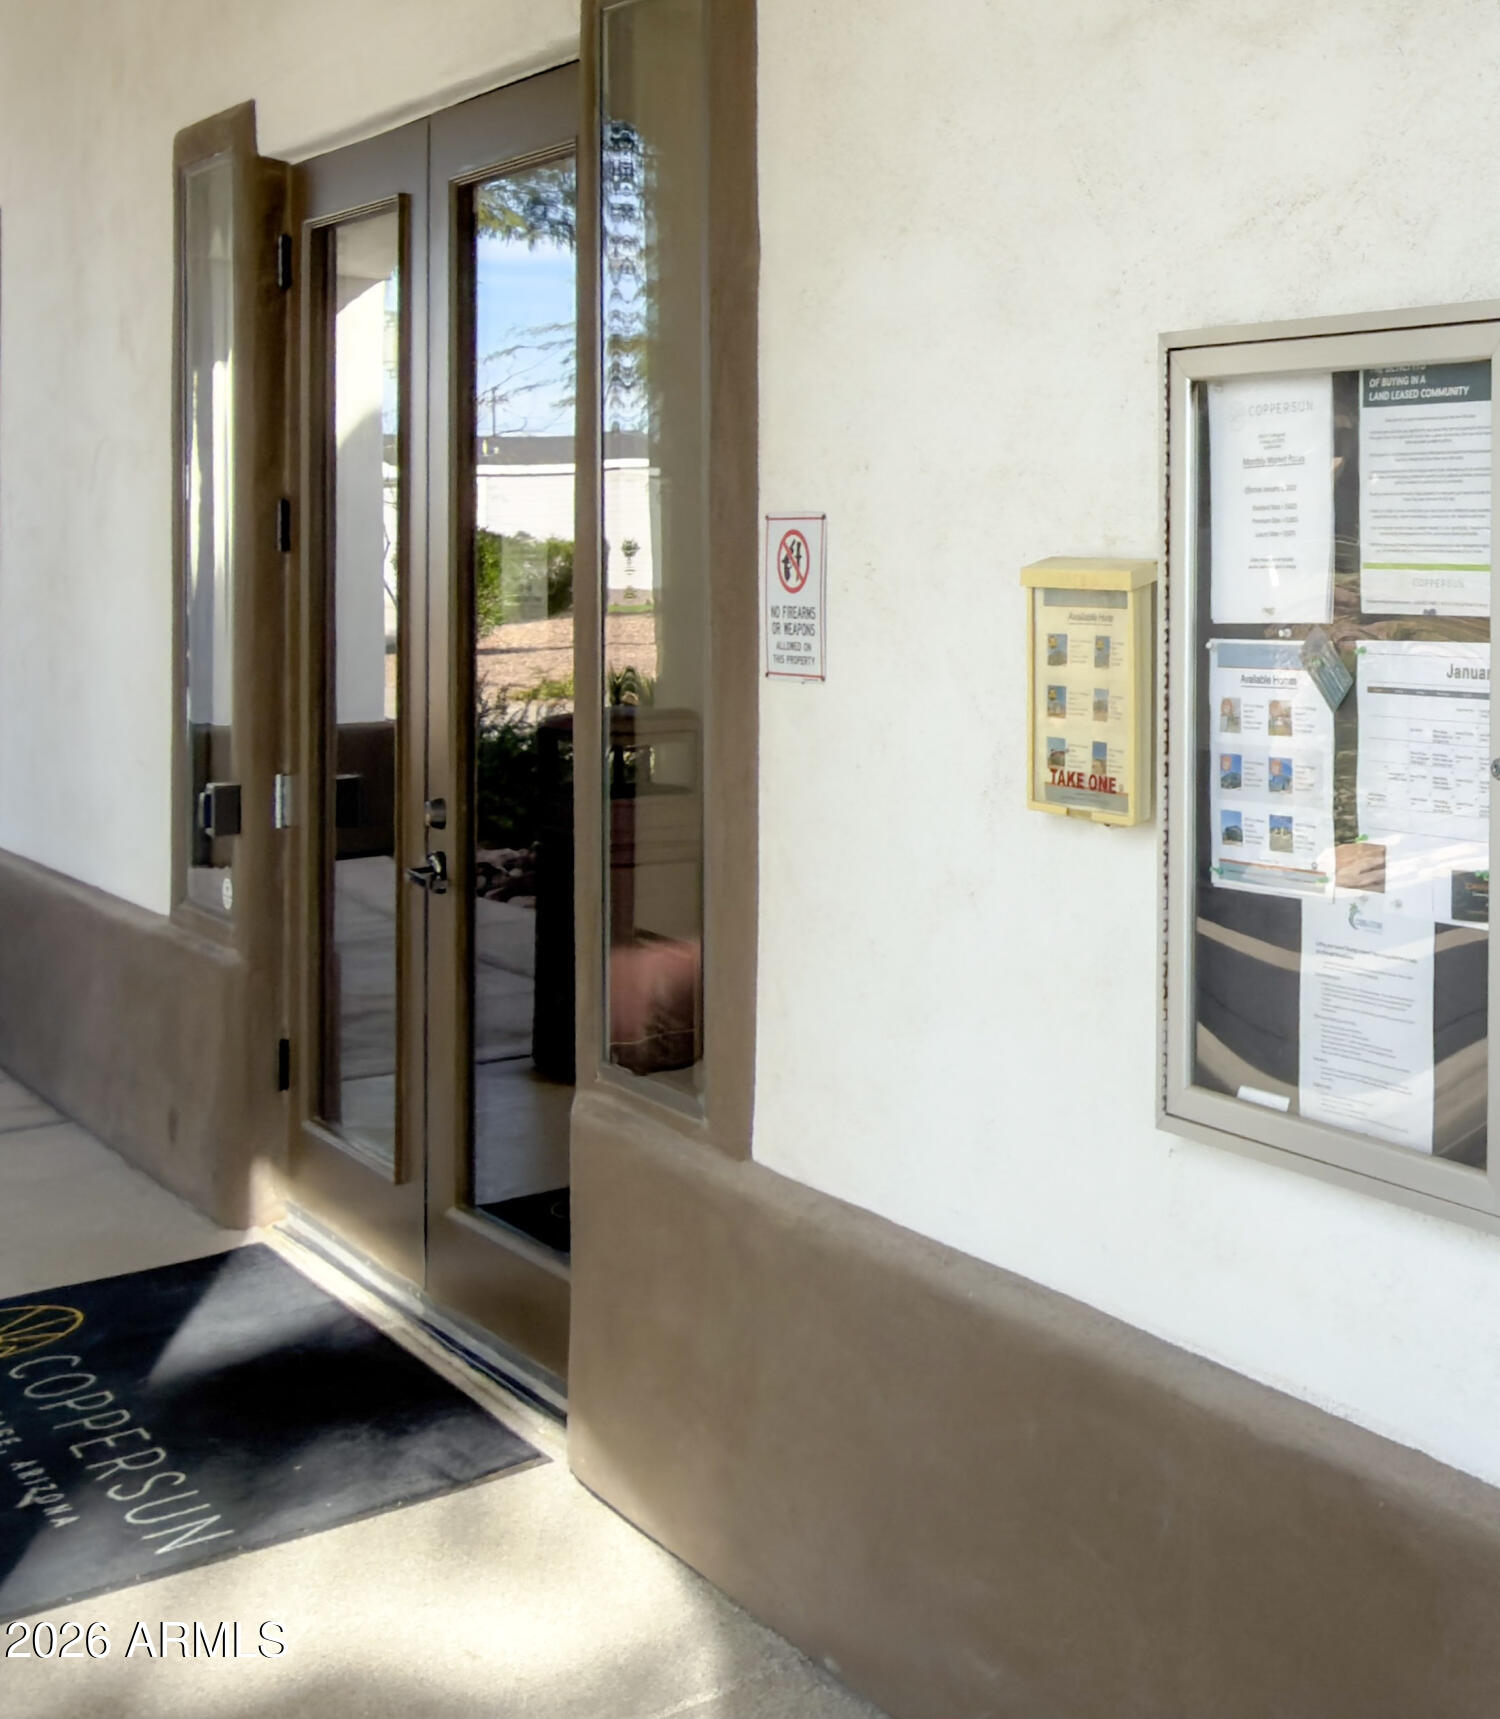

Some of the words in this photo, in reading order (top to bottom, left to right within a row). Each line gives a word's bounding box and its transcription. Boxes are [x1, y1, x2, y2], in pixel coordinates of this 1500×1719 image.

[1369, 379, 1380, 387] OF
[1382, 376, 1409, 386] BUYING
[1411, 375, 1419, 384] IN
[1369, 391, 1389, 401] LAND
[1391, 389, 1419, 400] LEASED
[1420, 386, 1470, 398] COMMUNITY
[1248, 400, 1313, 416] COPPERSUN
[771, 606, 780, 618] NO
[782, 606, 816, 619] FIREARMS
[772, 622, 781, 635] OR
[784, 623, 816, 636] WEAPONS
[1050, 768, 1085, 789] TAKE
[1089, 774, 1117, 793] ONE
[9, 1355, 235, 1556] COPPERSUN
[11, 1460, 80, 1528] ARIZONA
